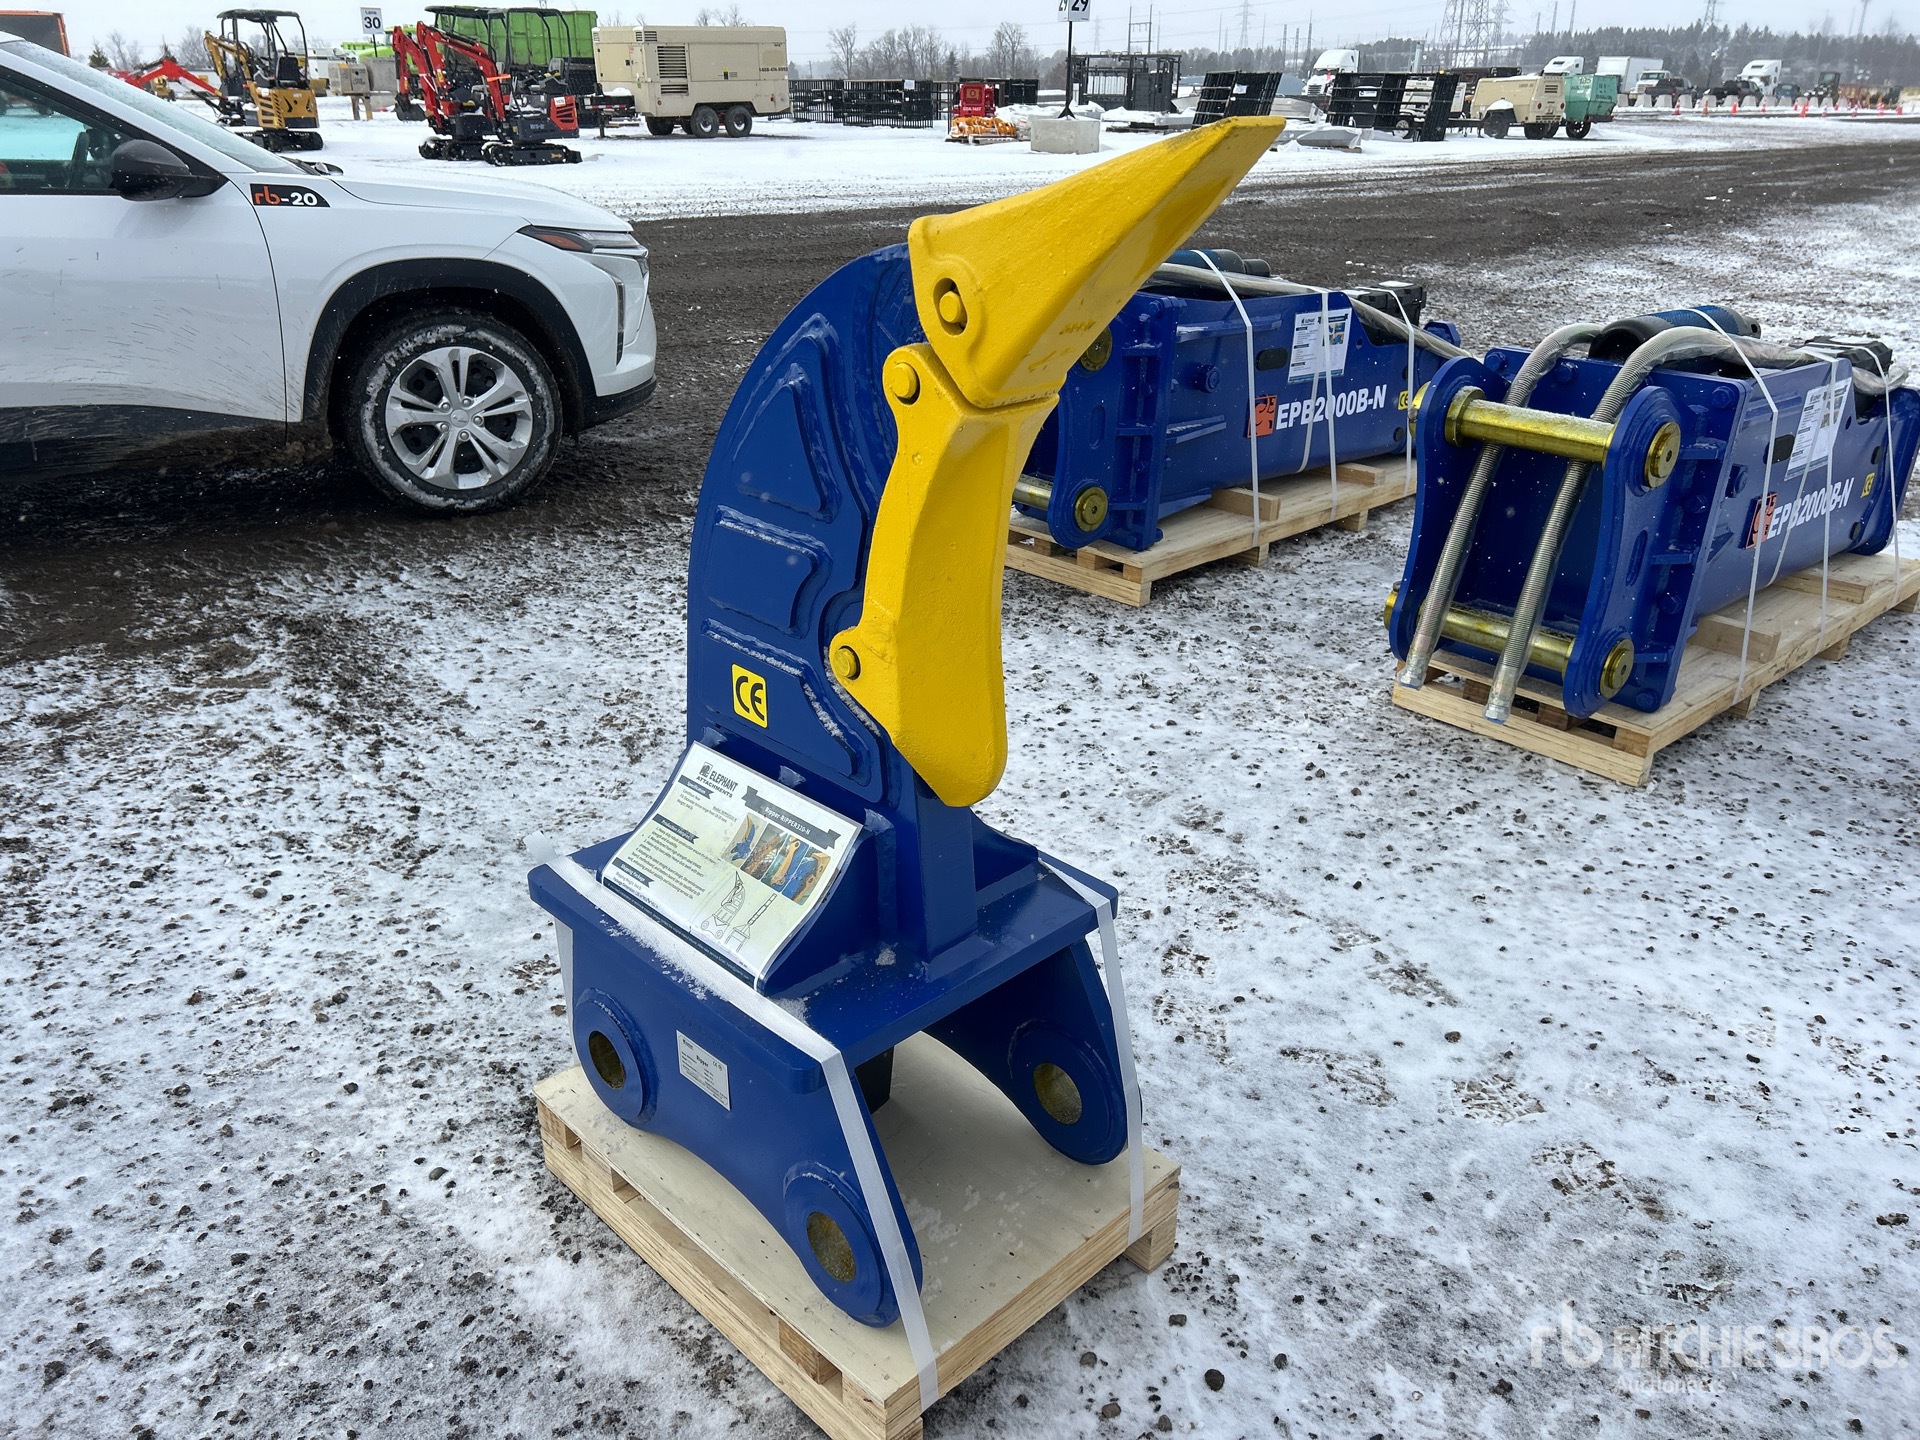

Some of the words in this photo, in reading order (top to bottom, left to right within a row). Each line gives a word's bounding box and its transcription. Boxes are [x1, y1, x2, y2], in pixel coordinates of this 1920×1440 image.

[364, 17, 381, 29] 30
[735, 675, 765, 721] CE
[696, 776, 733, 798] ATTACHMENTS
[709, 770, 739, 792] ELEPHANT
